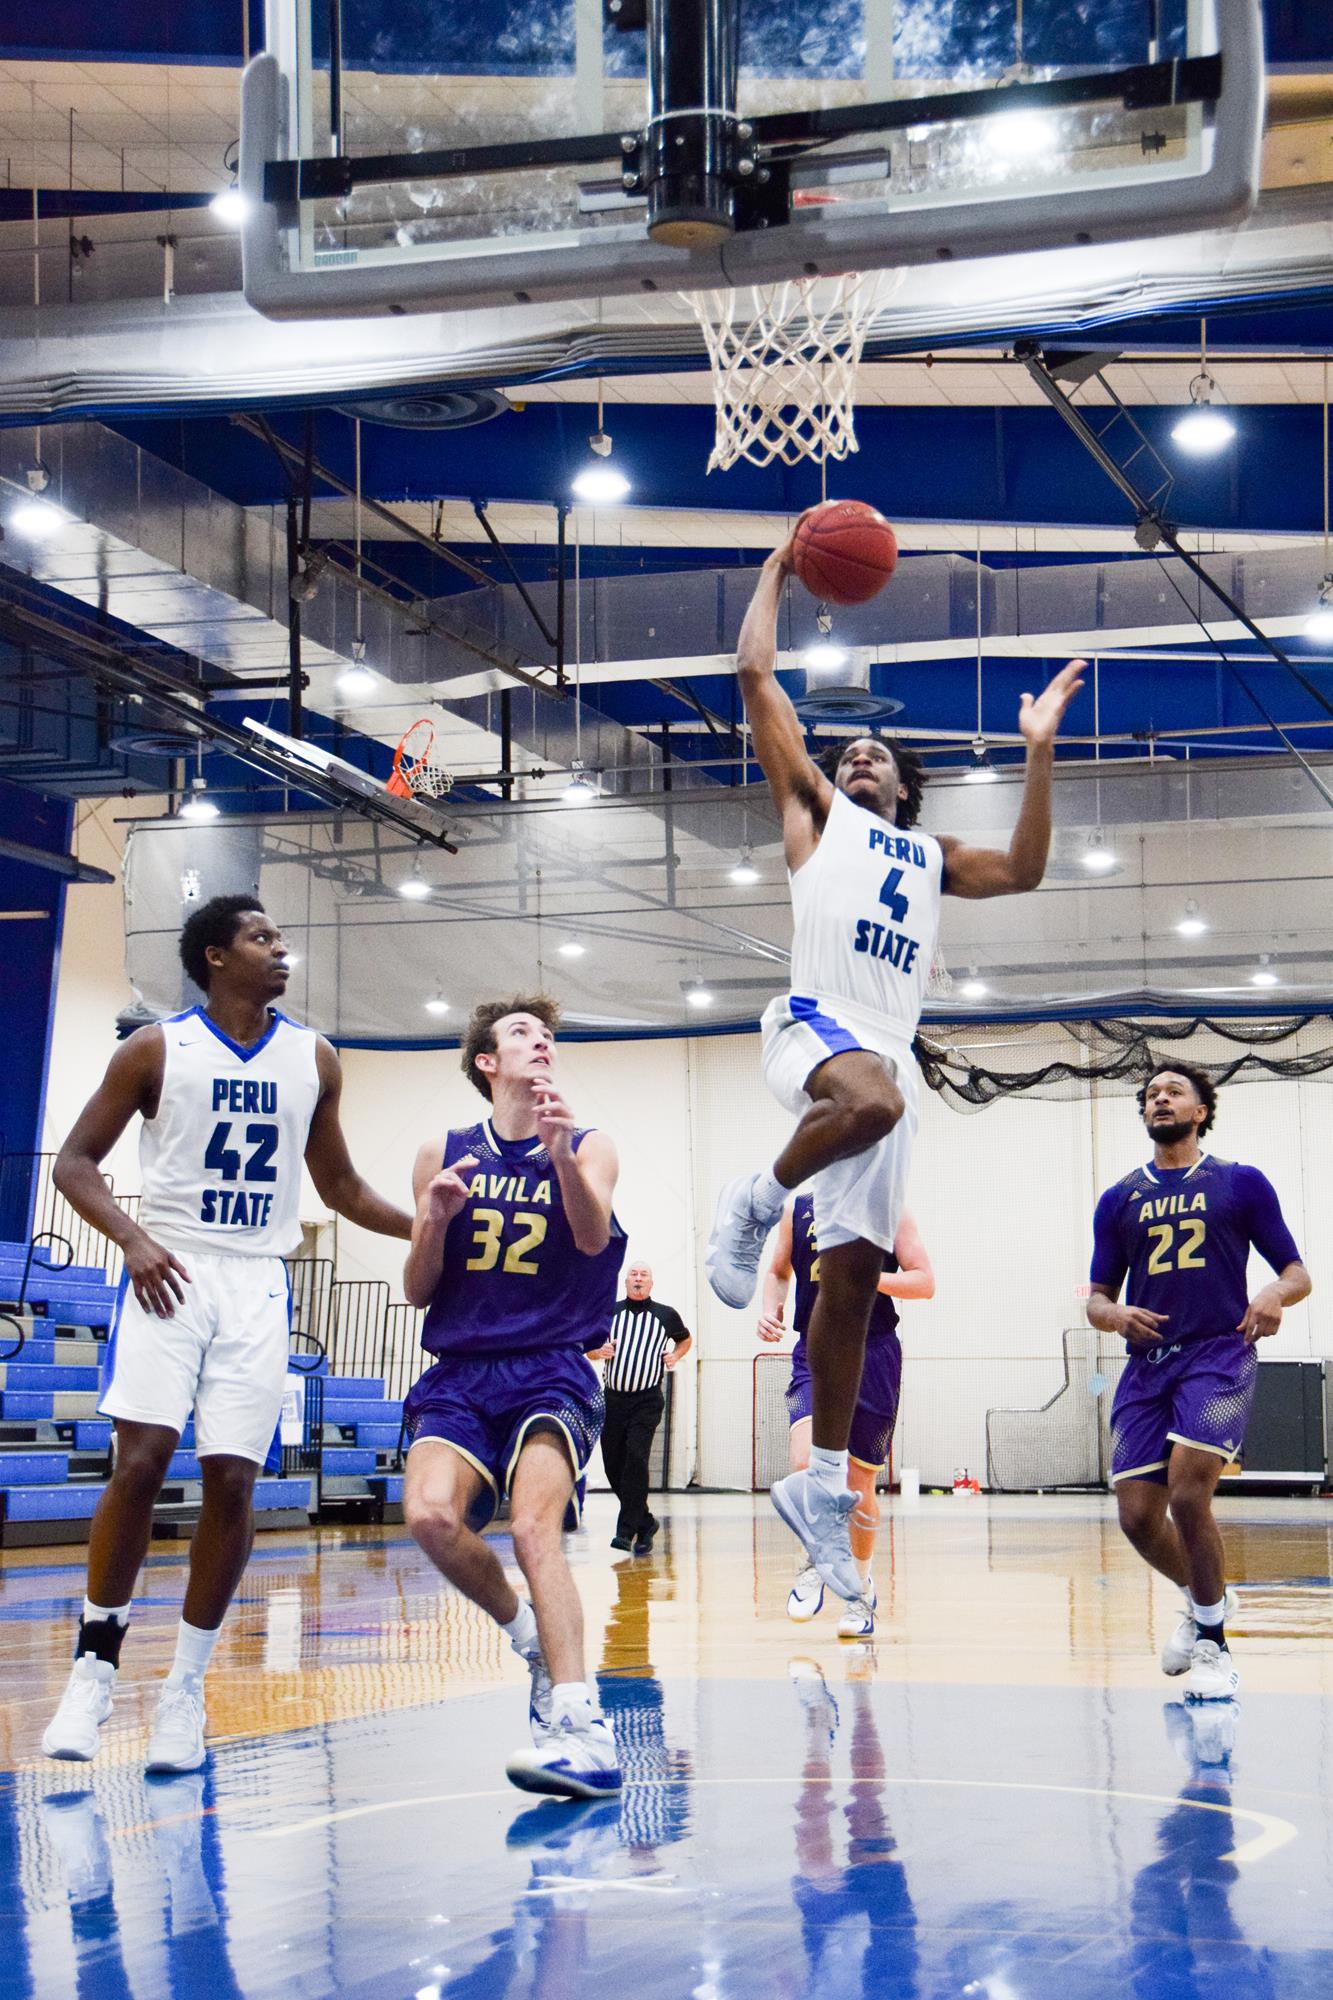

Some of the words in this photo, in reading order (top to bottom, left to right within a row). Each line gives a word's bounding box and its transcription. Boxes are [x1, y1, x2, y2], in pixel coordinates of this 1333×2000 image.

[869, 828, 926, 869] PERU
[879, 867, 909, 923] 4
[854, 919, 920, 974] STATE
[212, 1078, 277, 1114] PERU
[204, 1121, 279, 1182] 42
[200, 1189, 274, 1227] STATE
[467, 1173, 552, 1204] AVILA
[1139, 1192, 1207, 1223] AVILA
[466, 1208, 548, 1275] 32
[1147, 1218, 1206, 1276] 22
